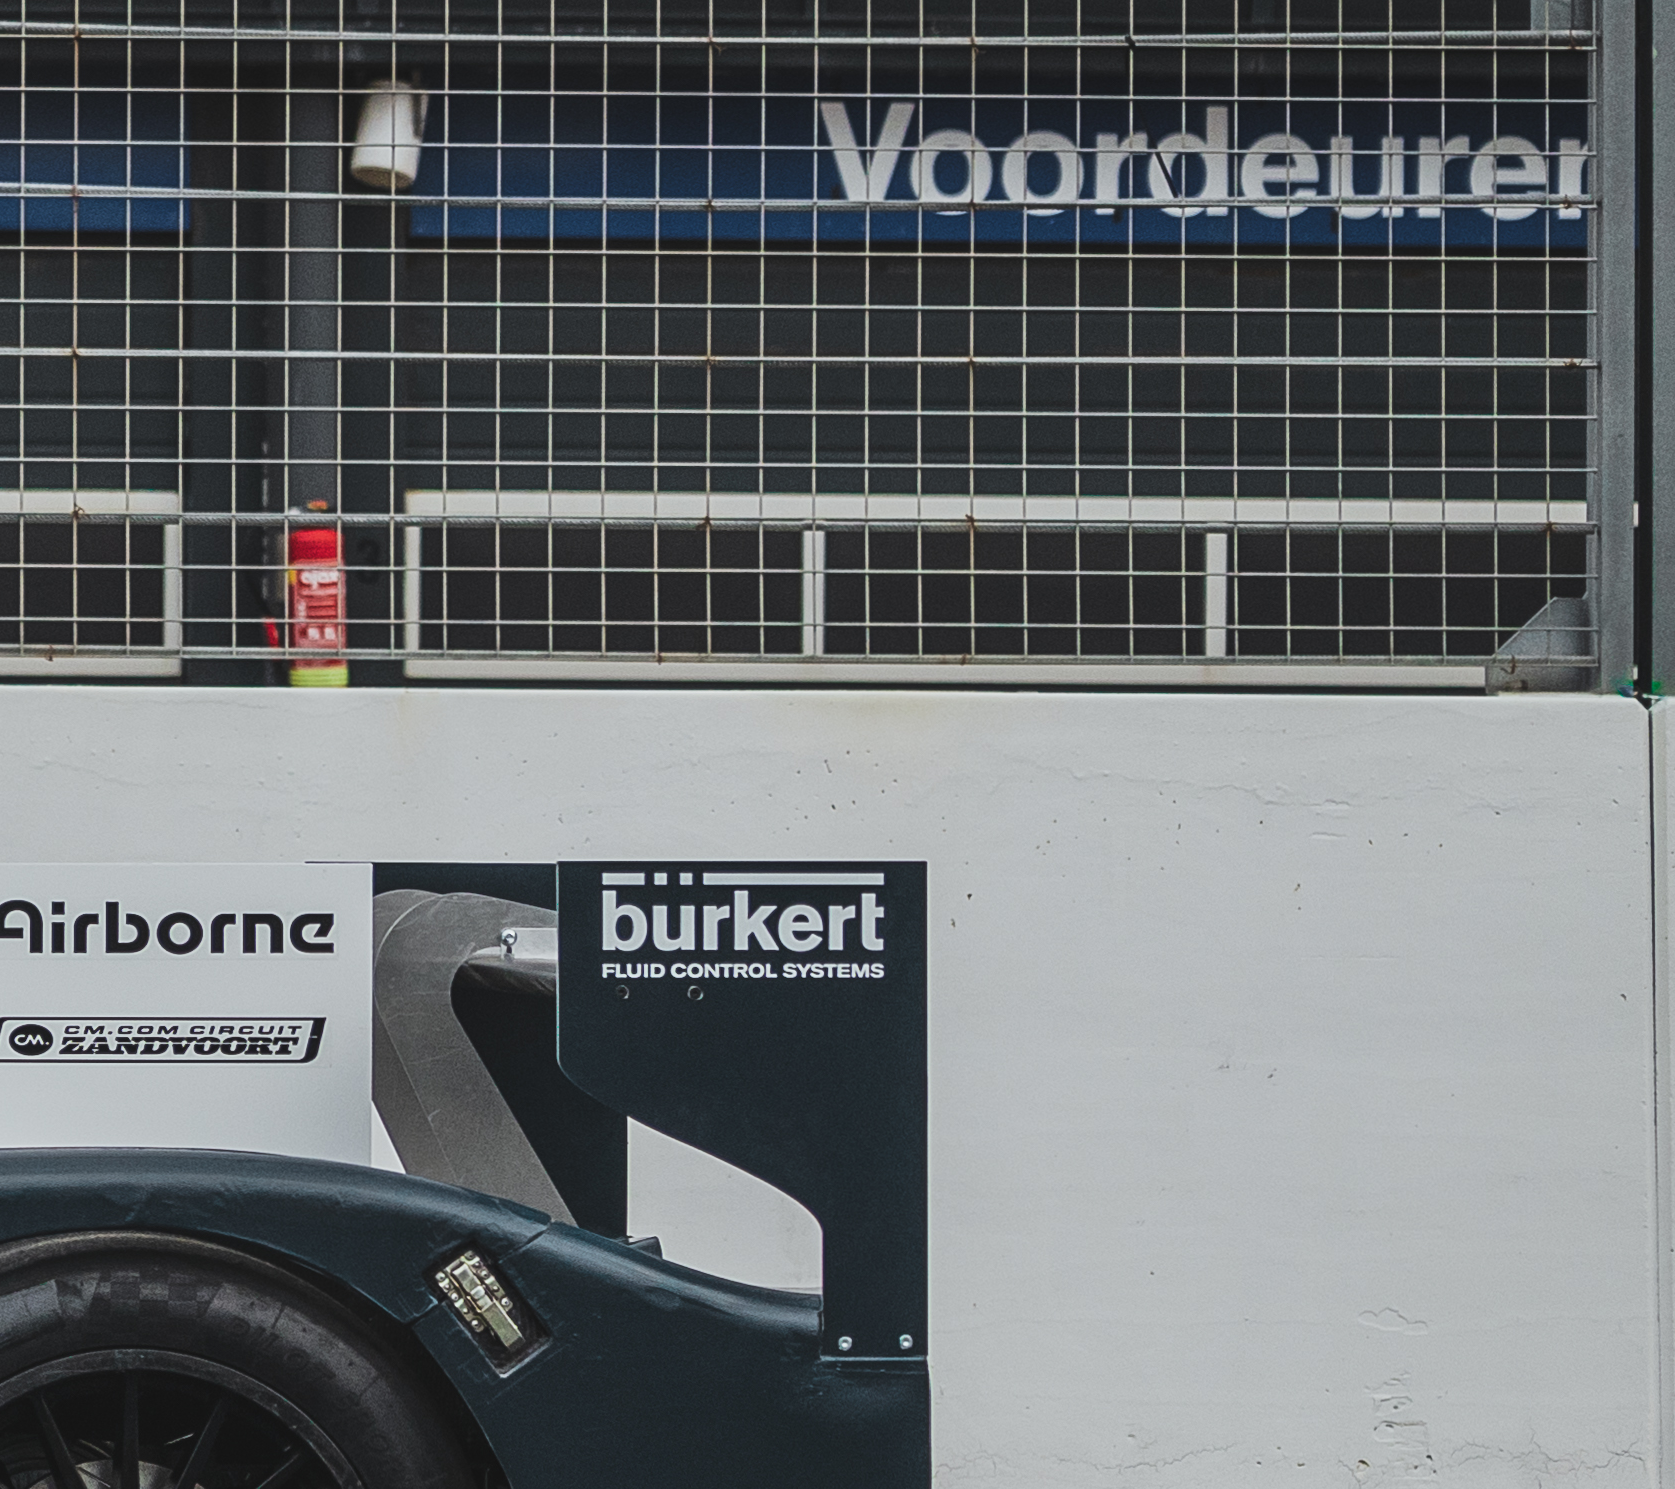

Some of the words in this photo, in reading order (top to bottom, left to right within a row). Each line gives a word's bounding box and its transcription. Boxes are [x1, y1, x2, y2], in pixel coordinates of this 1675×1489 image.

[602, 872, 885, 952] bürkert
[602, 963, 666, 979] FLUID
[670, 963, 778, 979] CONTROL
[782, 963, 885, 979] SYSTEMS
[63, 1025, 179, 1036] CM.COM
[189, 1025, 303, 1036] CIRCUIT
[58, 1036, 300, 1056] ZANDVOORT
